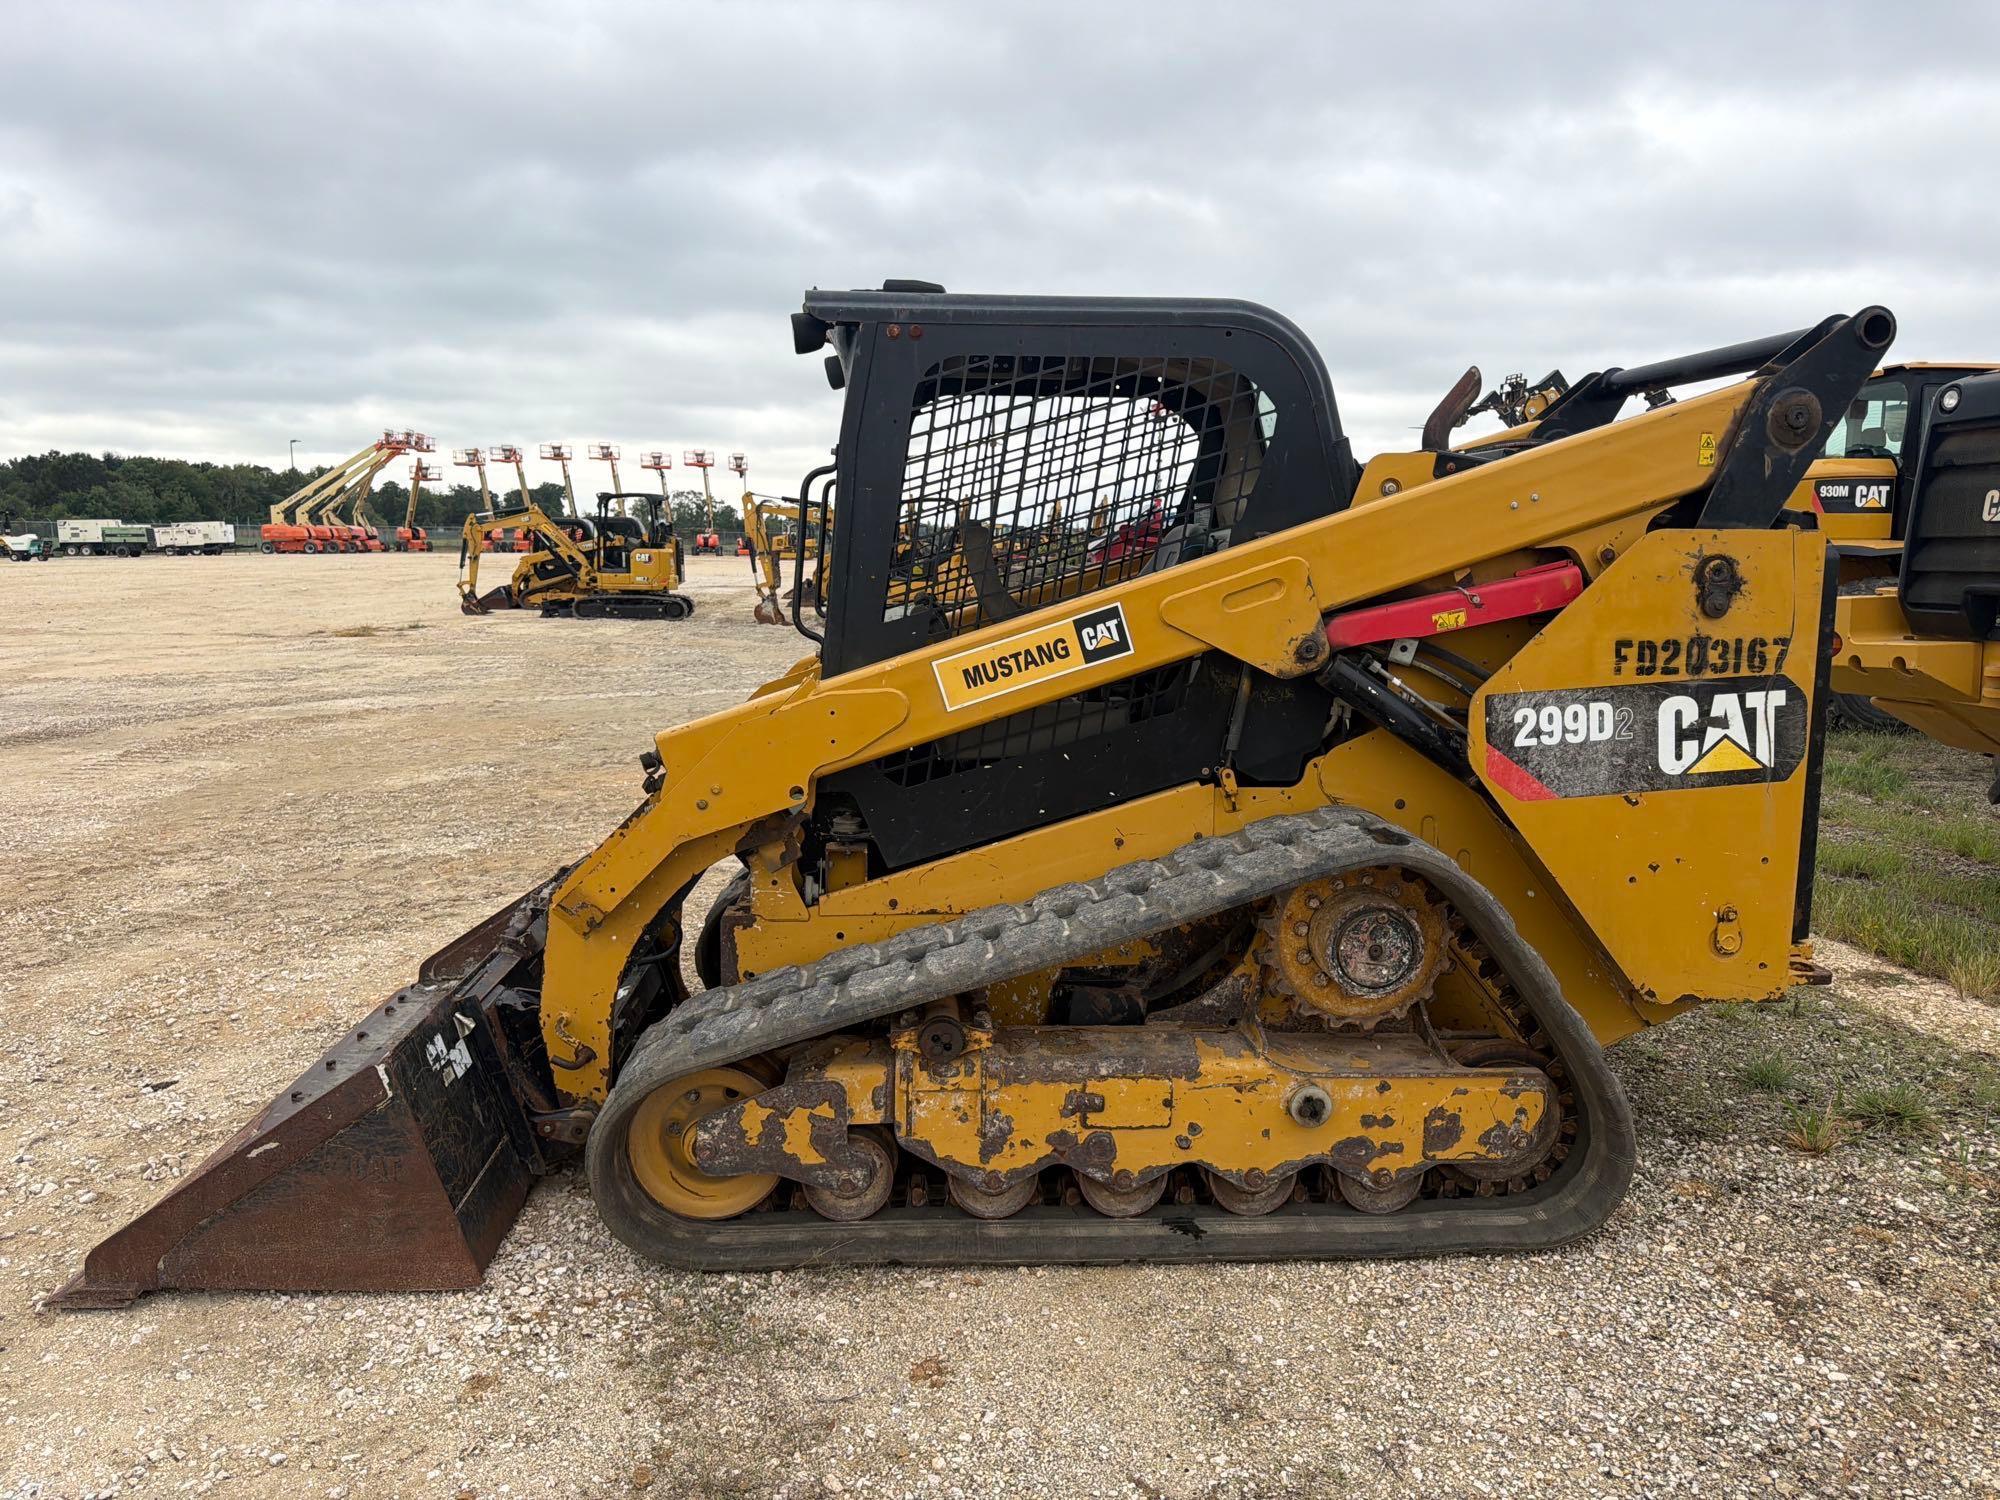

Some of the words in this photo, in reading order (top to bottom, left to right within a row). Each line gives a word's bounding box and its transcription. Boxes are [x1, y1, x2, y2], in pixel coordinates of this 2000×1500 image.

[1820, 485, 1849, 498] 930M
[1855, 485, 1890, 508] CAT
[962, 637, 1071, 690] MUSTANG
[1081, 618, 1121, 652] CAT
[1613, 636, 1791, 677] FD203167
[1513, 702, 1634, 748] 299D2
[1658, 689, 1787, 776] CAT
